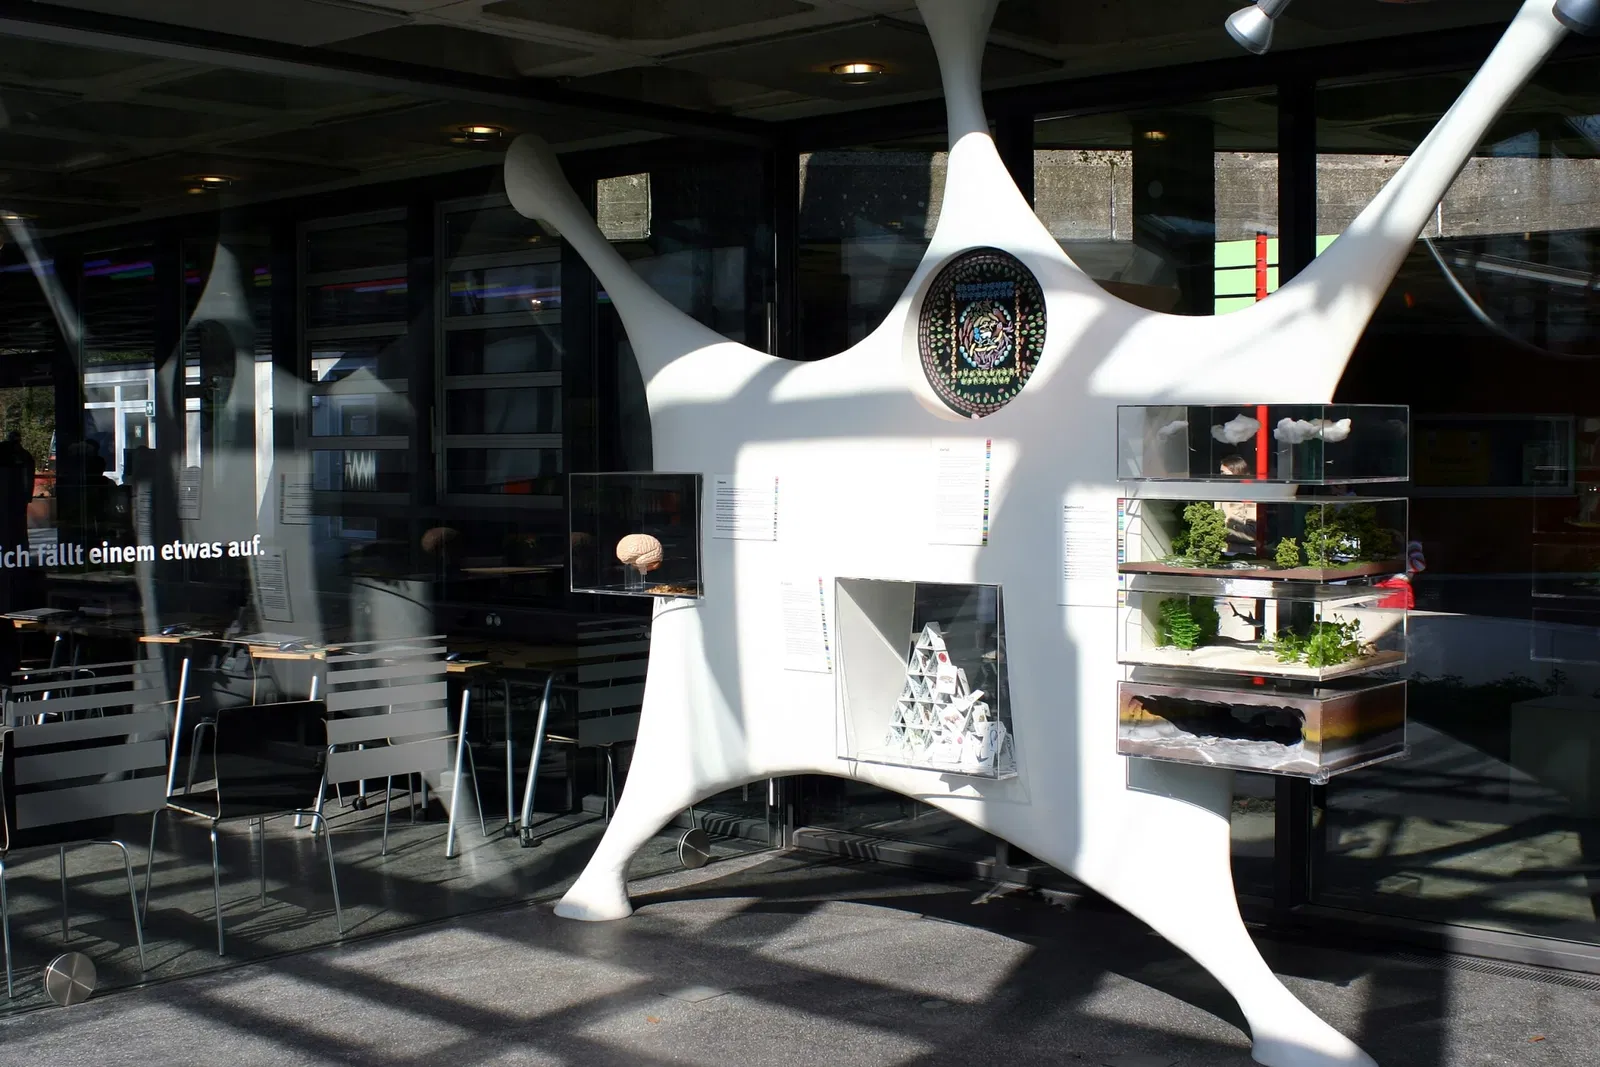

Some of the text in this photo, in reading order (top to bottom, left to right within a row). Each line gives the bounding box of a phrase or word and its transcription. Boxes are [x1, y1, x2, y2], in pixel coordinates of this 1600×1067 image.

[37, 542, 84, 567] fällt
[89, 541, 155, 564] einem
[161, 539, 222, 560] etwas
[228, 534, 265, 556] auf.
